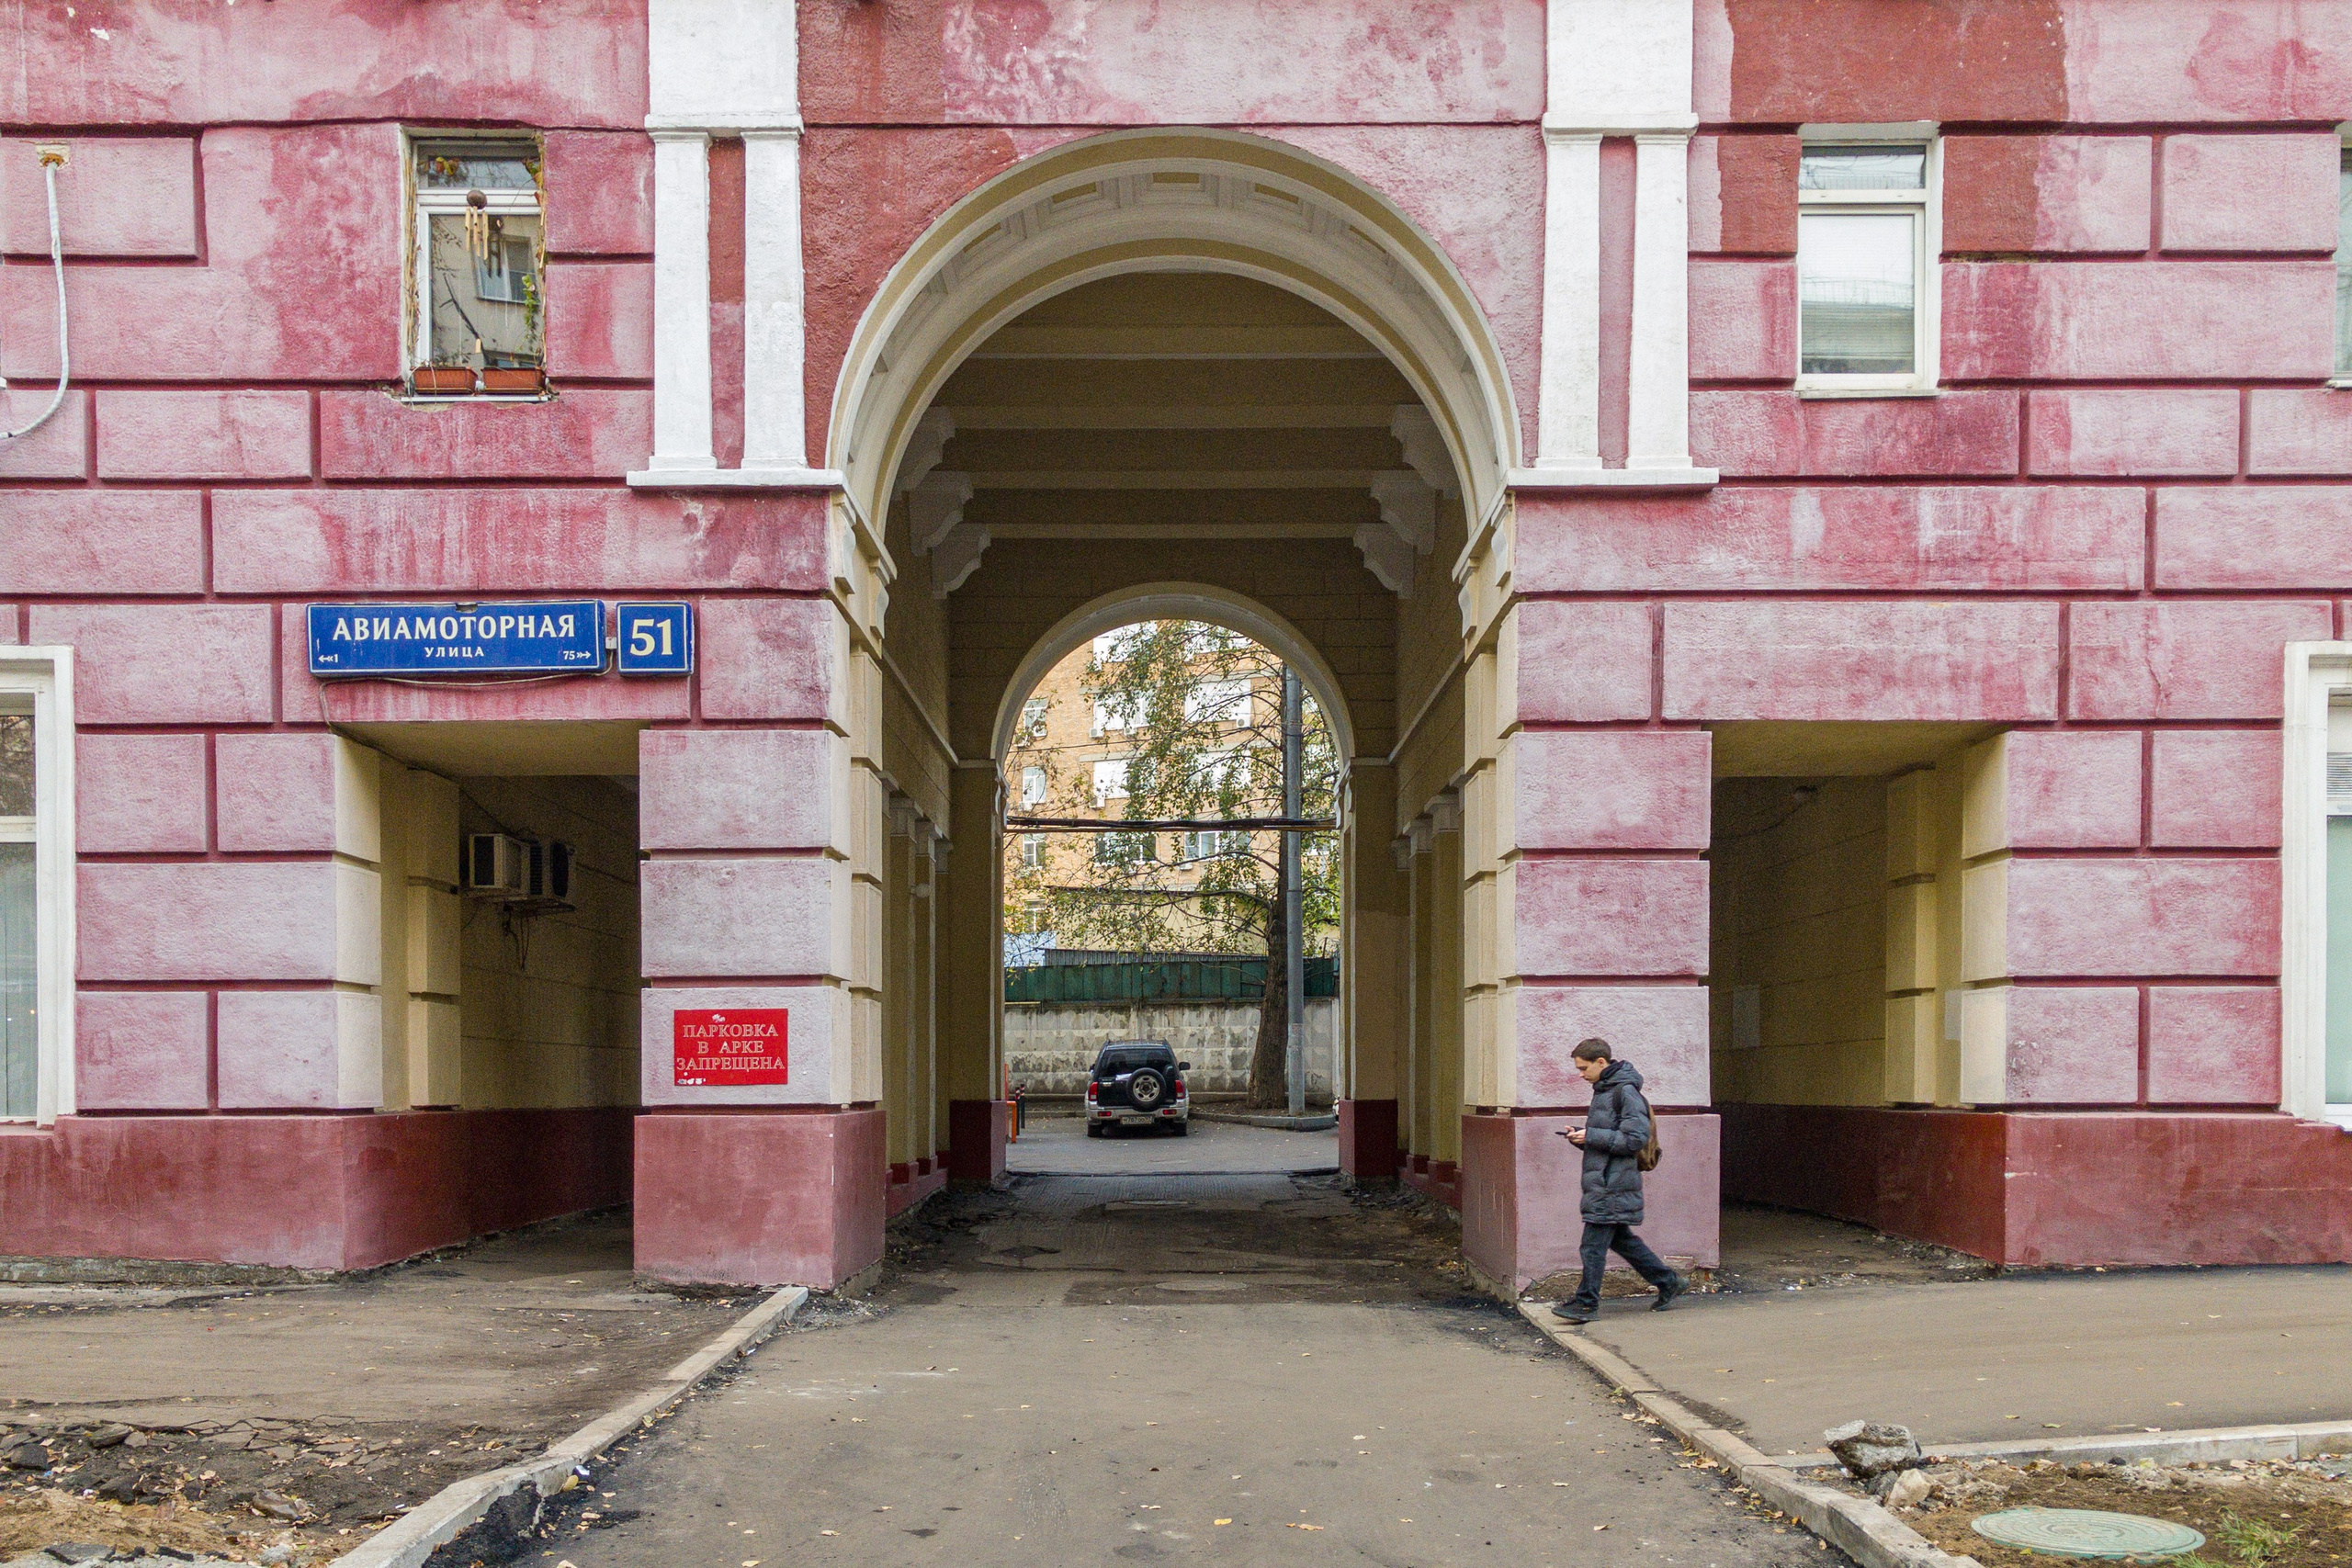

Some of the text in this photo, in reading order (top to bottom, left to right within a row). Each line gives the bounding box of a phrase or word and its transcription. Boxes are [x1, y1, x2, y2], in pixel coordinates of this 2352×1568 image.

[332, 615, 575, 640] АВИАМОТОРНАЯ
[629, 618, 673, 656] 51
[334, 654, 339, 663] 1
[424, 646, 484, 658] УЛИЦА
[562, 650, 575, 660] 75
[683, 1023, 778, 1037] ПАРКОВКА
[697, 1040, 764, 1054] В АРКЕ
[676, 1056, 785, 1072] ЗАПРЕЩЕНА
